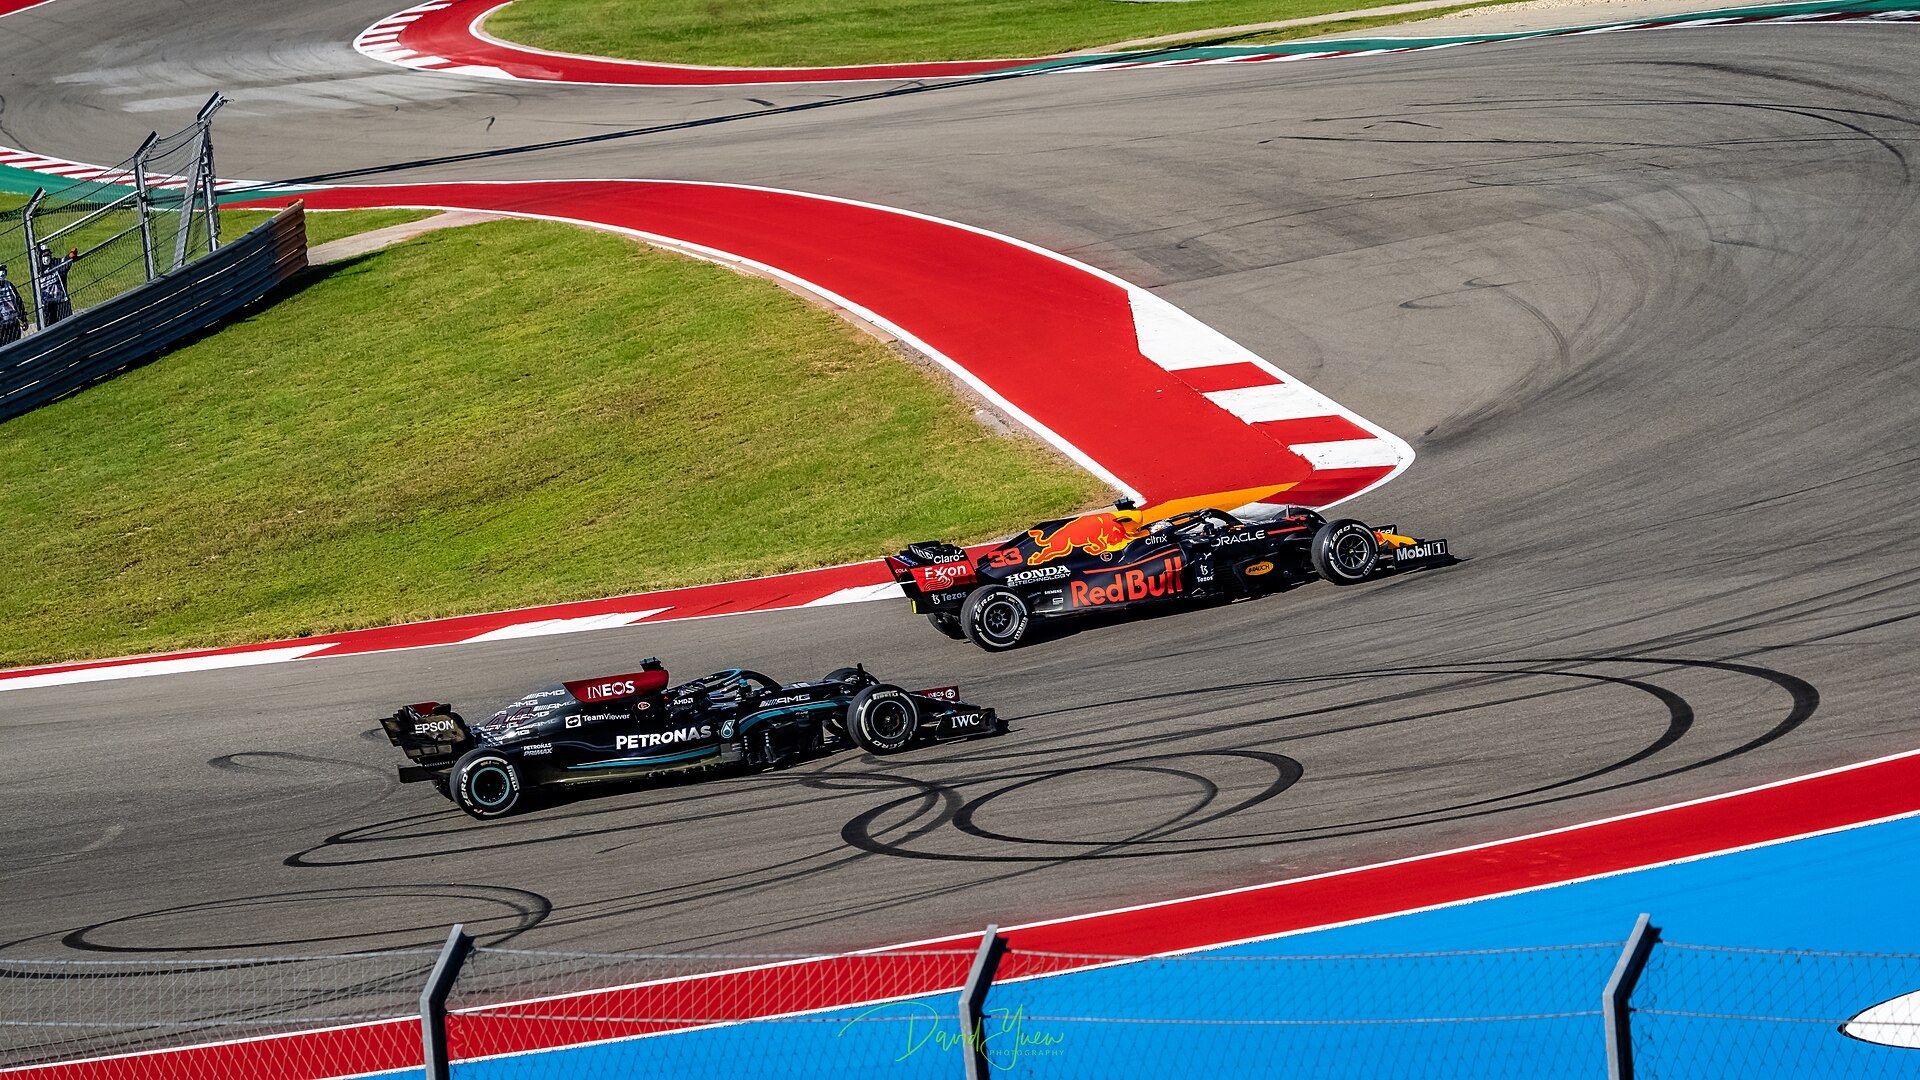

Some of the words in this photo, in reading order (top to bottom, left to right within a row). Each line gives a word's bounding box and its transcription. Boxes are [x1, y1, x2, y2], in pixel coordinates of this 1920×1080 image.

[934, 553, 961, 564] Claro
[988, 547, 1023, 568] 33
[1396, 544, 1431, 561] Mobil
[924, 564, 967, 580] Exxon
[1005, 565, 1071, 583] HONDA
[1070, 573, 1125, 608] Red
[1125, 556, 1183, 601] Bull
[941, 591, 967, 601] Tezos
[587, 680, 635, 699] INEOS
[582, 713, 631, 723] TeamViewer
[951, 713, 980, 729] IWC
[415, 719, 454, 734] EPSON
[616, 725, 712, 750] PETRONAS
[523, 743, 552, 751] PETRONAS
